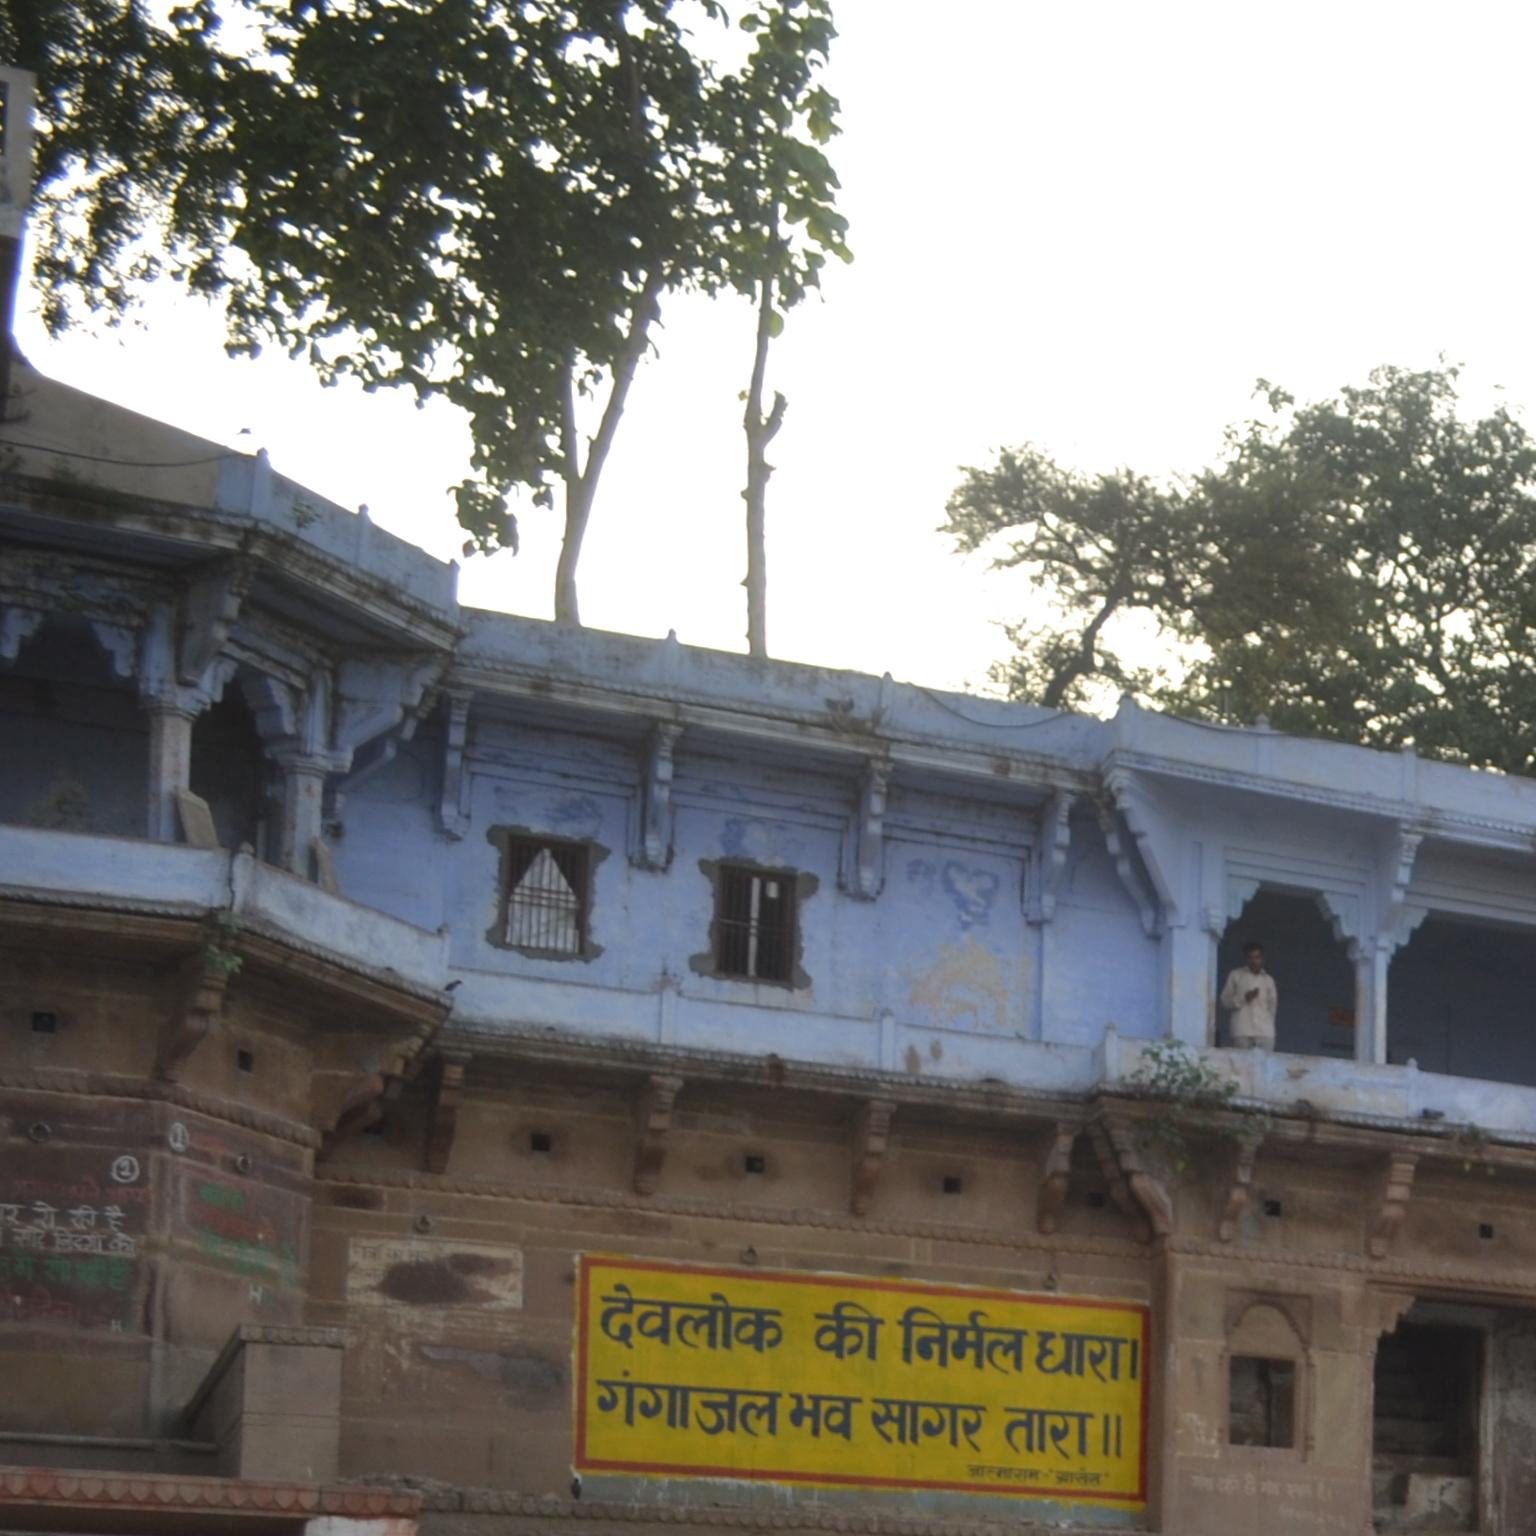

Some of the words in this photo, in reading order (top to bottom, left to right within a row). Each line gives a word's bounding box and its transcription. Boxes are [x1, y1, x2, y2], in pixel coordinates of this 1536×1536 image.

[601, 1283, 783, 1352] देवलोक
[814, 1302, 884, 1361] की
[898, 1306, 1027, 1373] निर्मल
[790, 1392, 862, 1441] भव
[871, 1397, 987, 1453] सागर
